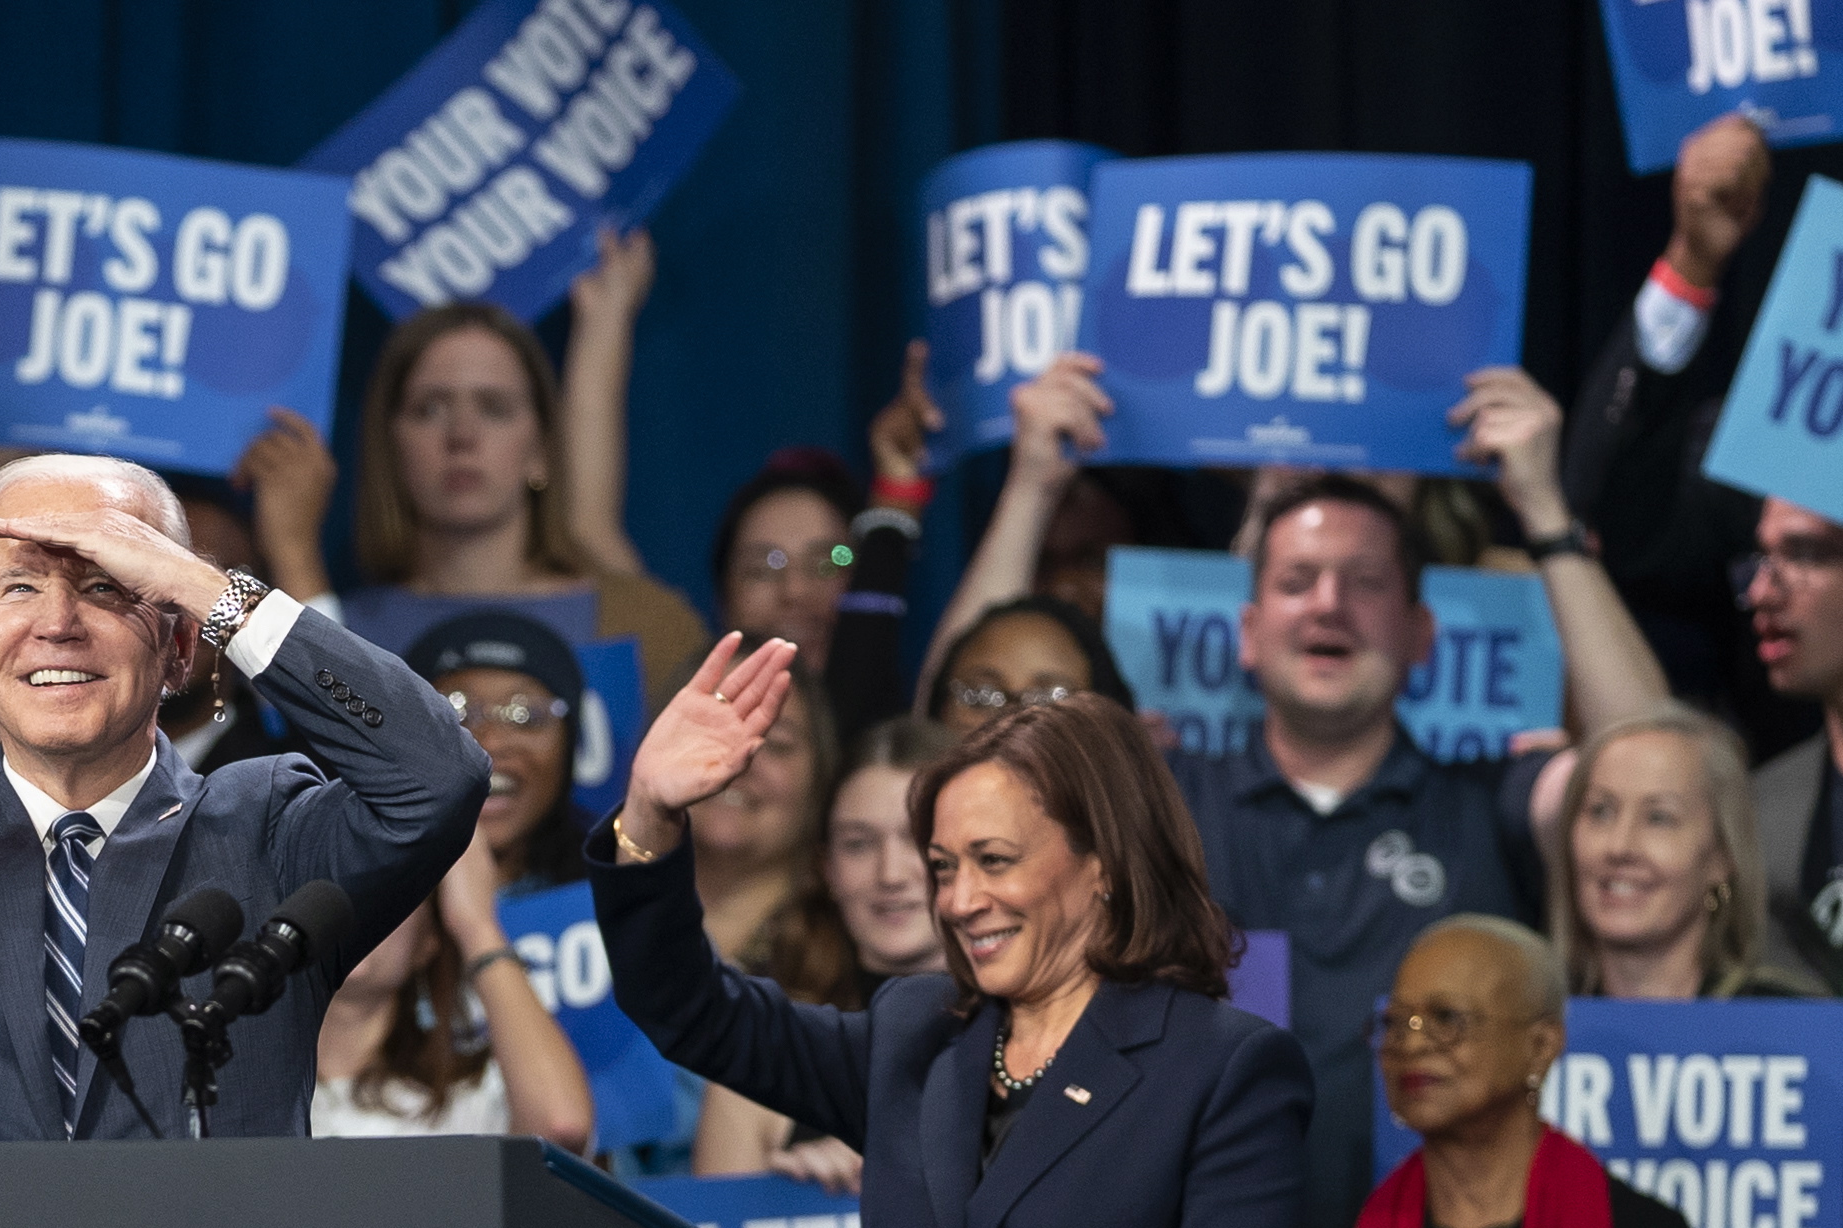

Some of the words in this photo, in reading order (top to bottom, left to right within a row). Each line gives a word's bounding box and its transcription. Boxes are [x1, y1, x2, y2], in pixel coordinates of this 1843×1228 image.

[1687, 0, 1819, 95] JOE!
[350, 88, 527, 242] YOUR
[483, 0, 633, 118] VOT
[380, 166, 574, 309] YOUR
[534, 5, 697, 198] VOICE
[173, 206, 290, 312] GO
[927, 185, 1090, 306] LET'S
[1125, 199, 1337, 299] LET'S
[1350, 201, 1468, 307] GO
[15, 288, 193, 400] JOE!
[1194, 300, 1372, 403] JOE!
[1151, 609, 1255, 692] YO
[1627, 1053, 1808, 1149] VOTE
